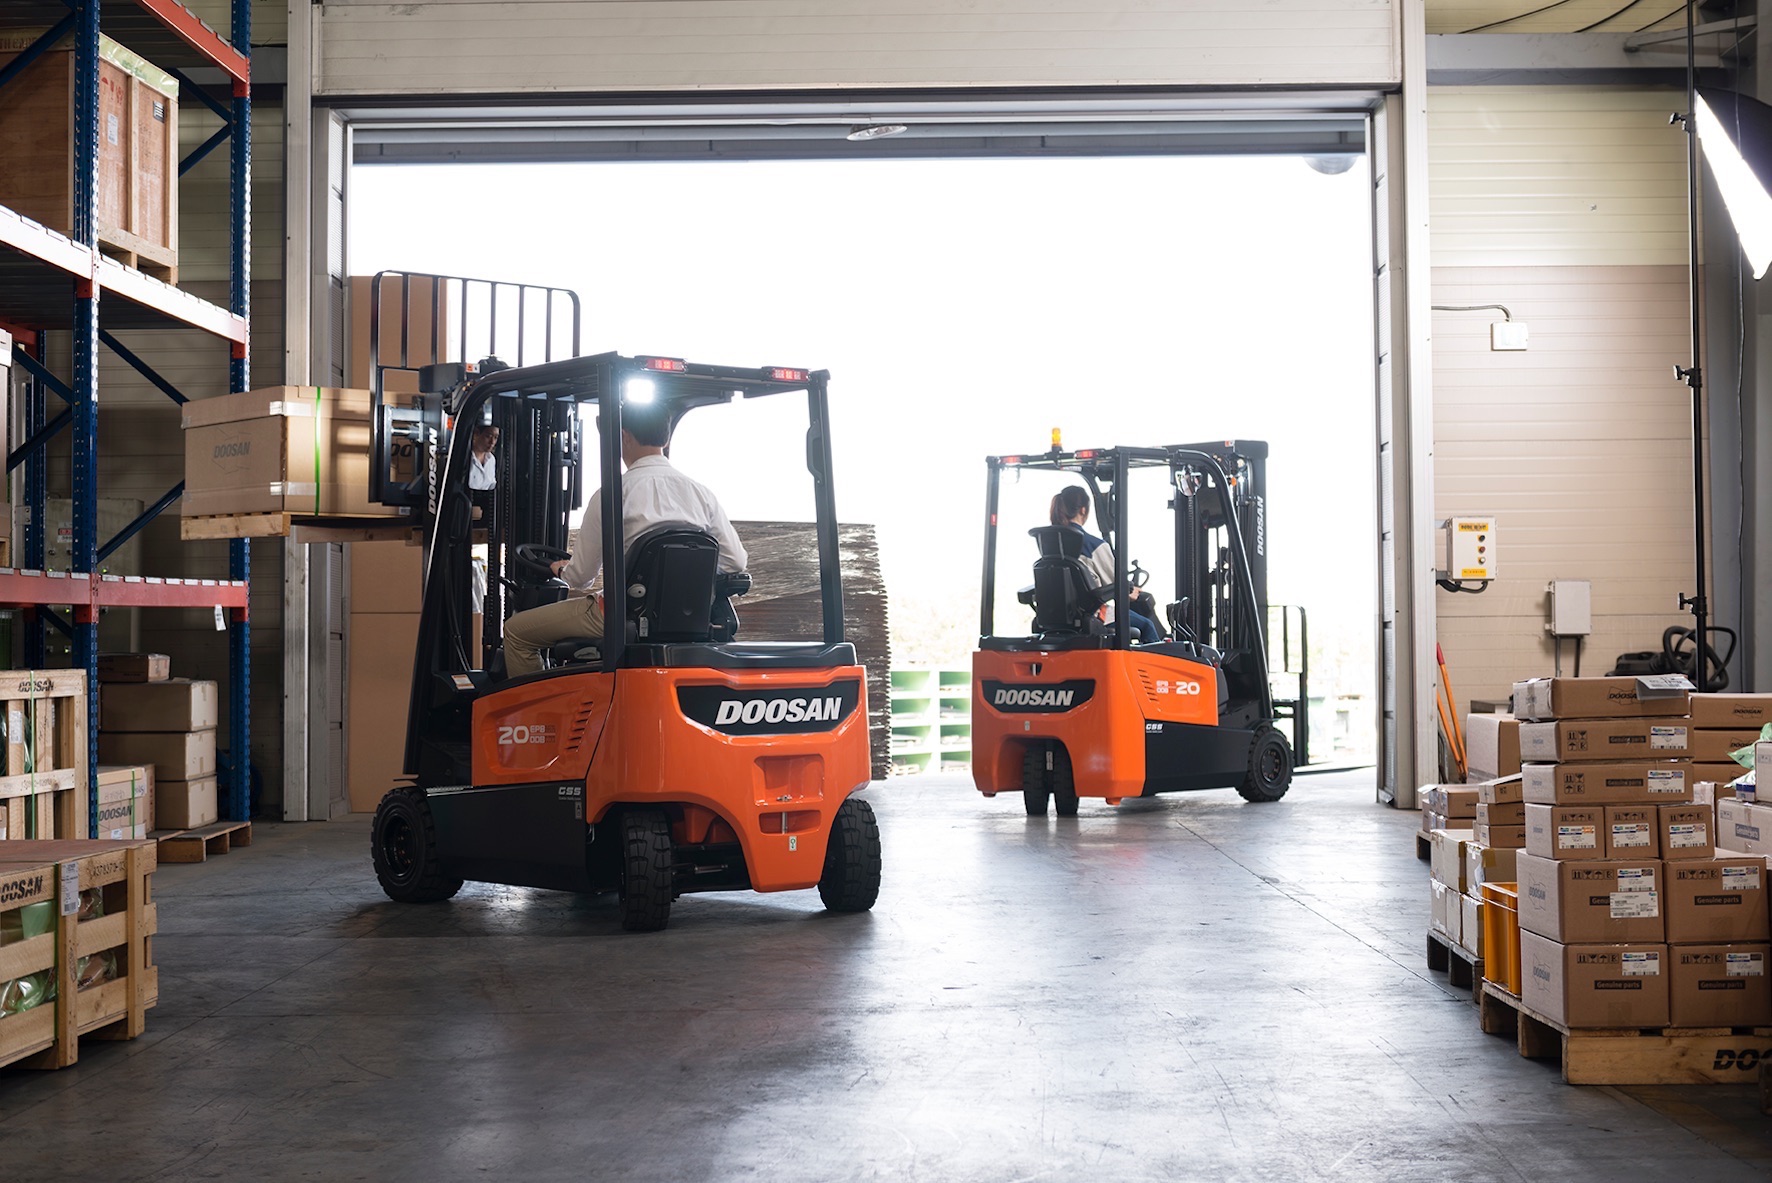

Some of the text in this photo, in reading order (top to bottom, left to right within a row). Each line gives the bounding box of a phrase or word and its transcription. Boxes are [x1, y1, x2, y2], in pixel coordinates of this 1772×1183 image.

[214, 441, 251, 458] DOOSAN
[428, 427, 437, 515] DOOSAN
[1175, 681, 1201, 695] 20
[1609, 692, 1638, 700] DOOSA
[995, 689, 1074, 706] DOOSAN
[715, 697, 842, 725] DOOSAN
[498, 725, 530, 745] 20
[98, 805, 132, 821] DOOSAN
[0, 875, 43, 904] OOSAN
[1723, 897, 1739, 905] parts
[1622, 981, 1640, 989] parts
[1726, 981, 1744, 989] parts
[1713, 1049, 1772, 1071] DO
